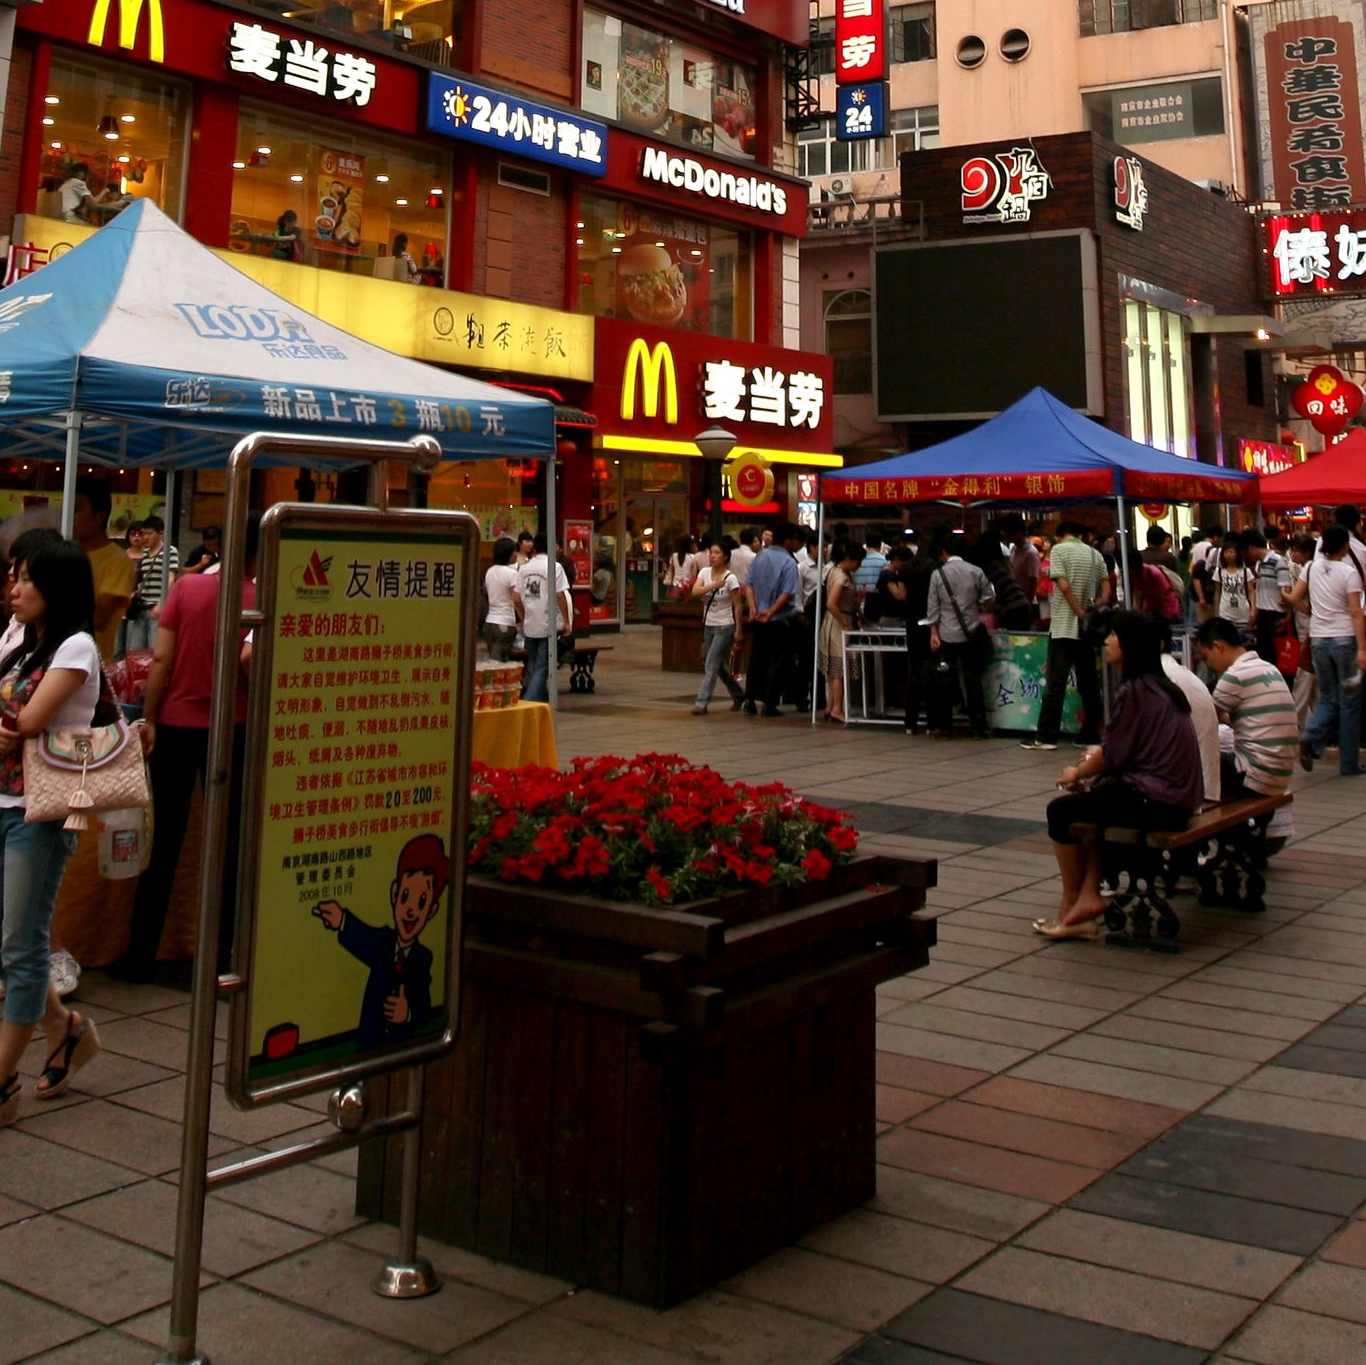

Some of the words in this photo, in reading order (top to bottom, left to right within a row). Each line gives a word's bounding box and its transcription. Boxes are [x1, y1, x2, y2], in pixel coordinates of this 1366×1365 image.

[230, 21, 377, 107] 麦当劳
[471, 94, 603, 164] 24小时营业
[846, 107, 873, 128] 24
[641, 147, 787, 217] McDonald's
[261, 385, 378, 427] 新品上市
[703, 360, 825, 428] 麦当劳
[844, 479, 918, 502] 中国名牌
[1024, 472, 1067, 495] 银饰
[345, 559, 456, 599] 友情提醒
